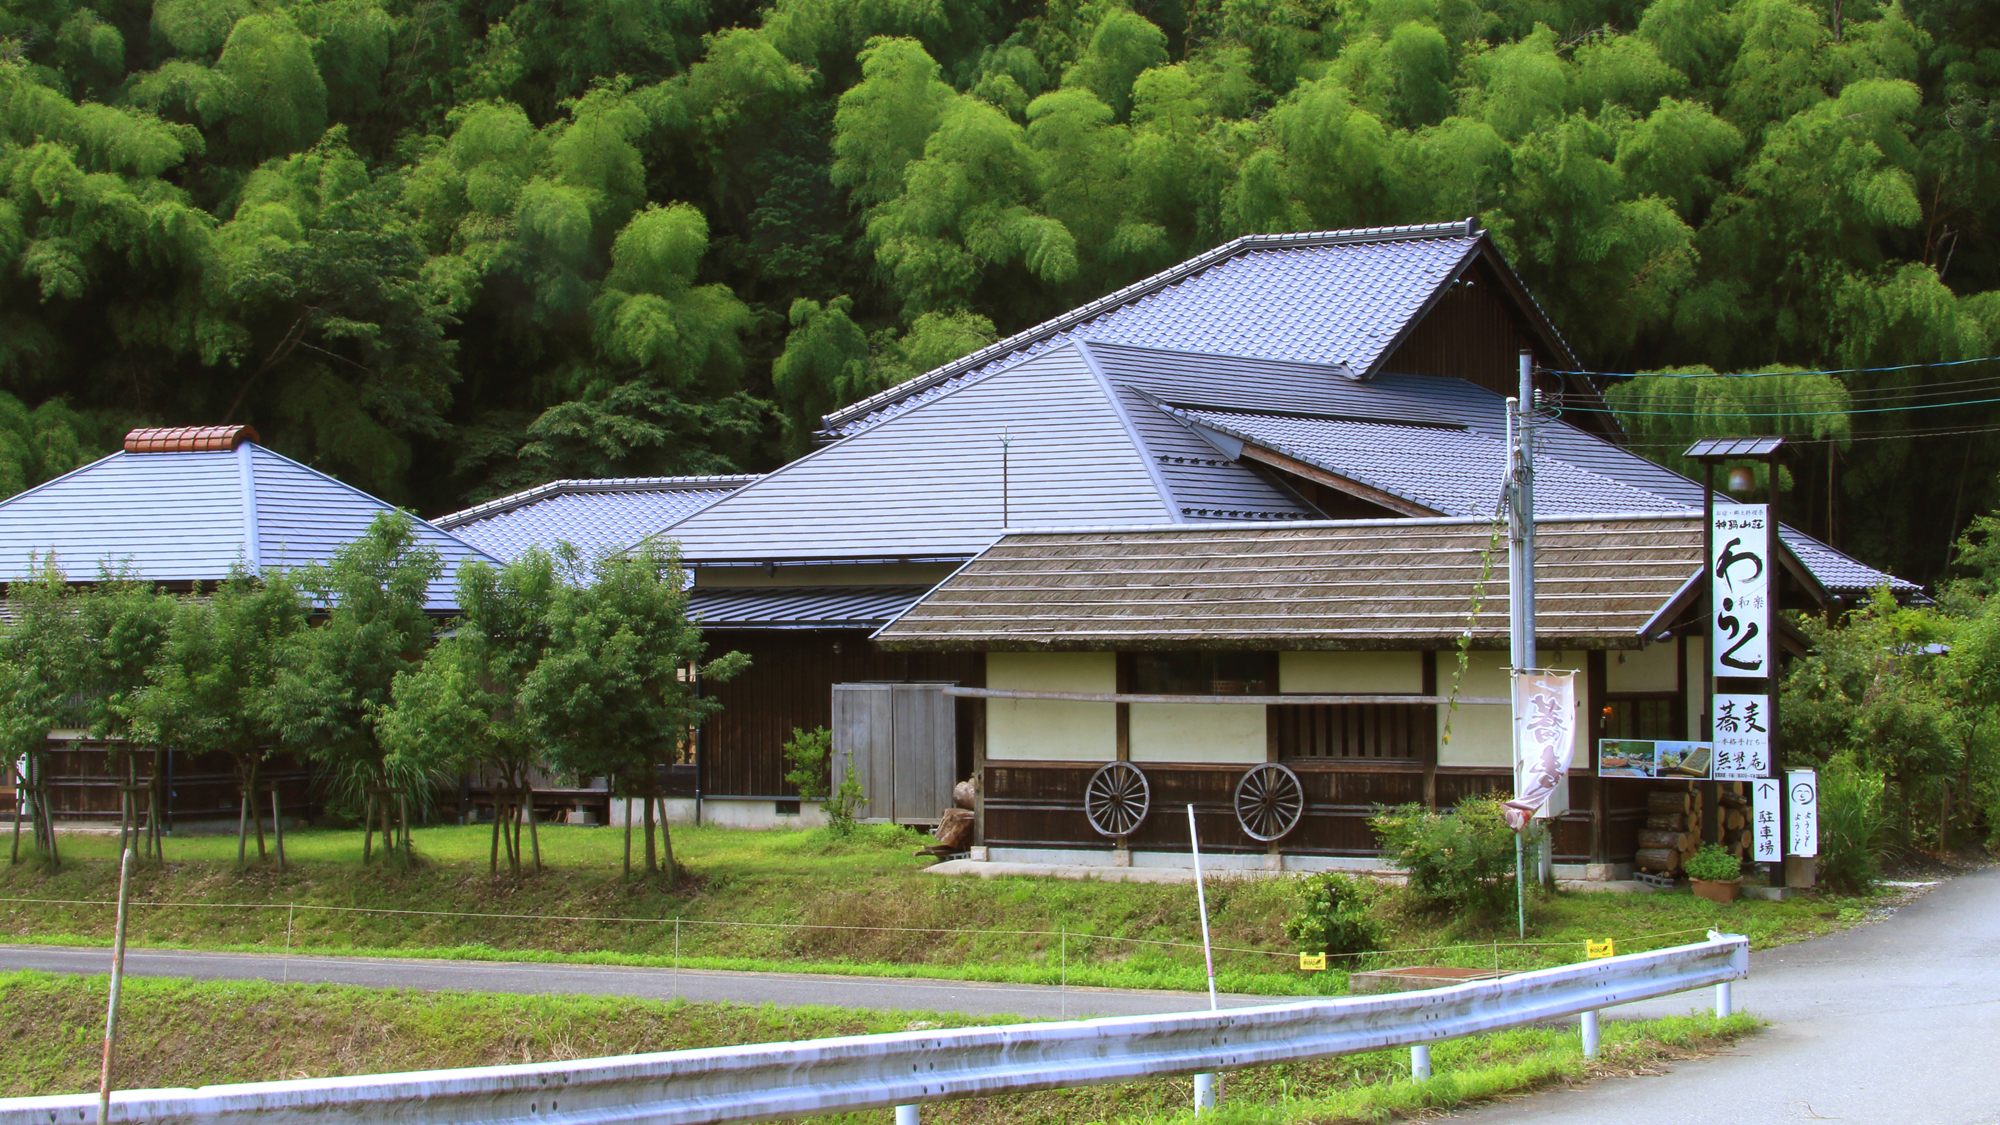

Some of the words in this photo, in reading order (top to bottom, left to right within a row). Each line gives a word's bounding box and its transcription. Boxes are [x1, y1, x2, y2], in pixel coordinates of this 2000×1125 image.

[1716, 537, 1763, 670] わらく
[1738, 595, 1764, 610] 和楽
[1715, 699, 1767, 733] 蕎麦
[1757, 810, 1775, 856] 駐車場
